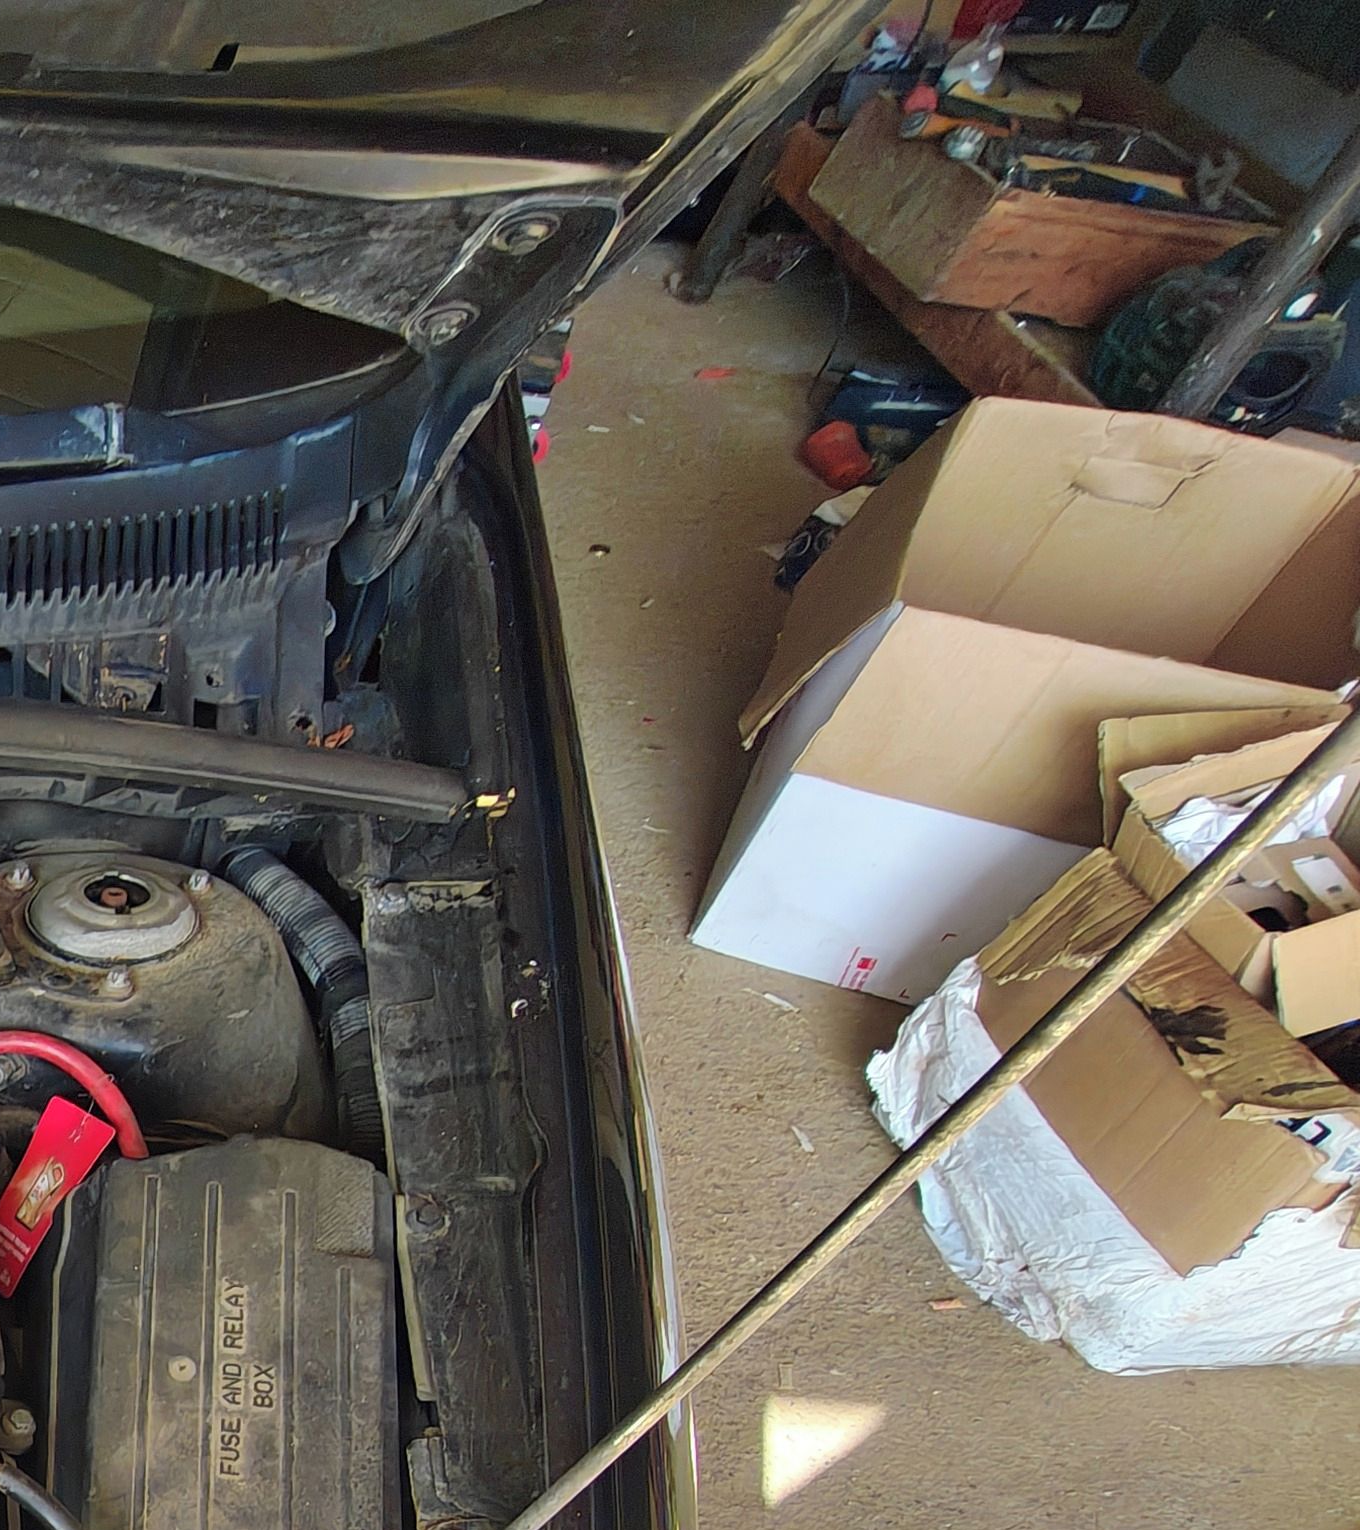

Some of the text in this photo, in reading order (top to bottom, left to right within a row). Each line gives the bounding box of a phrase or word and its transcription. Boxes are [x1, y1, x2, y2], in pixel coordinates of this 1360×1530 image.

[219, 1278, 248, 1477] FUSE AND RELAY
[252, 1363, 277, 1409] BOX
